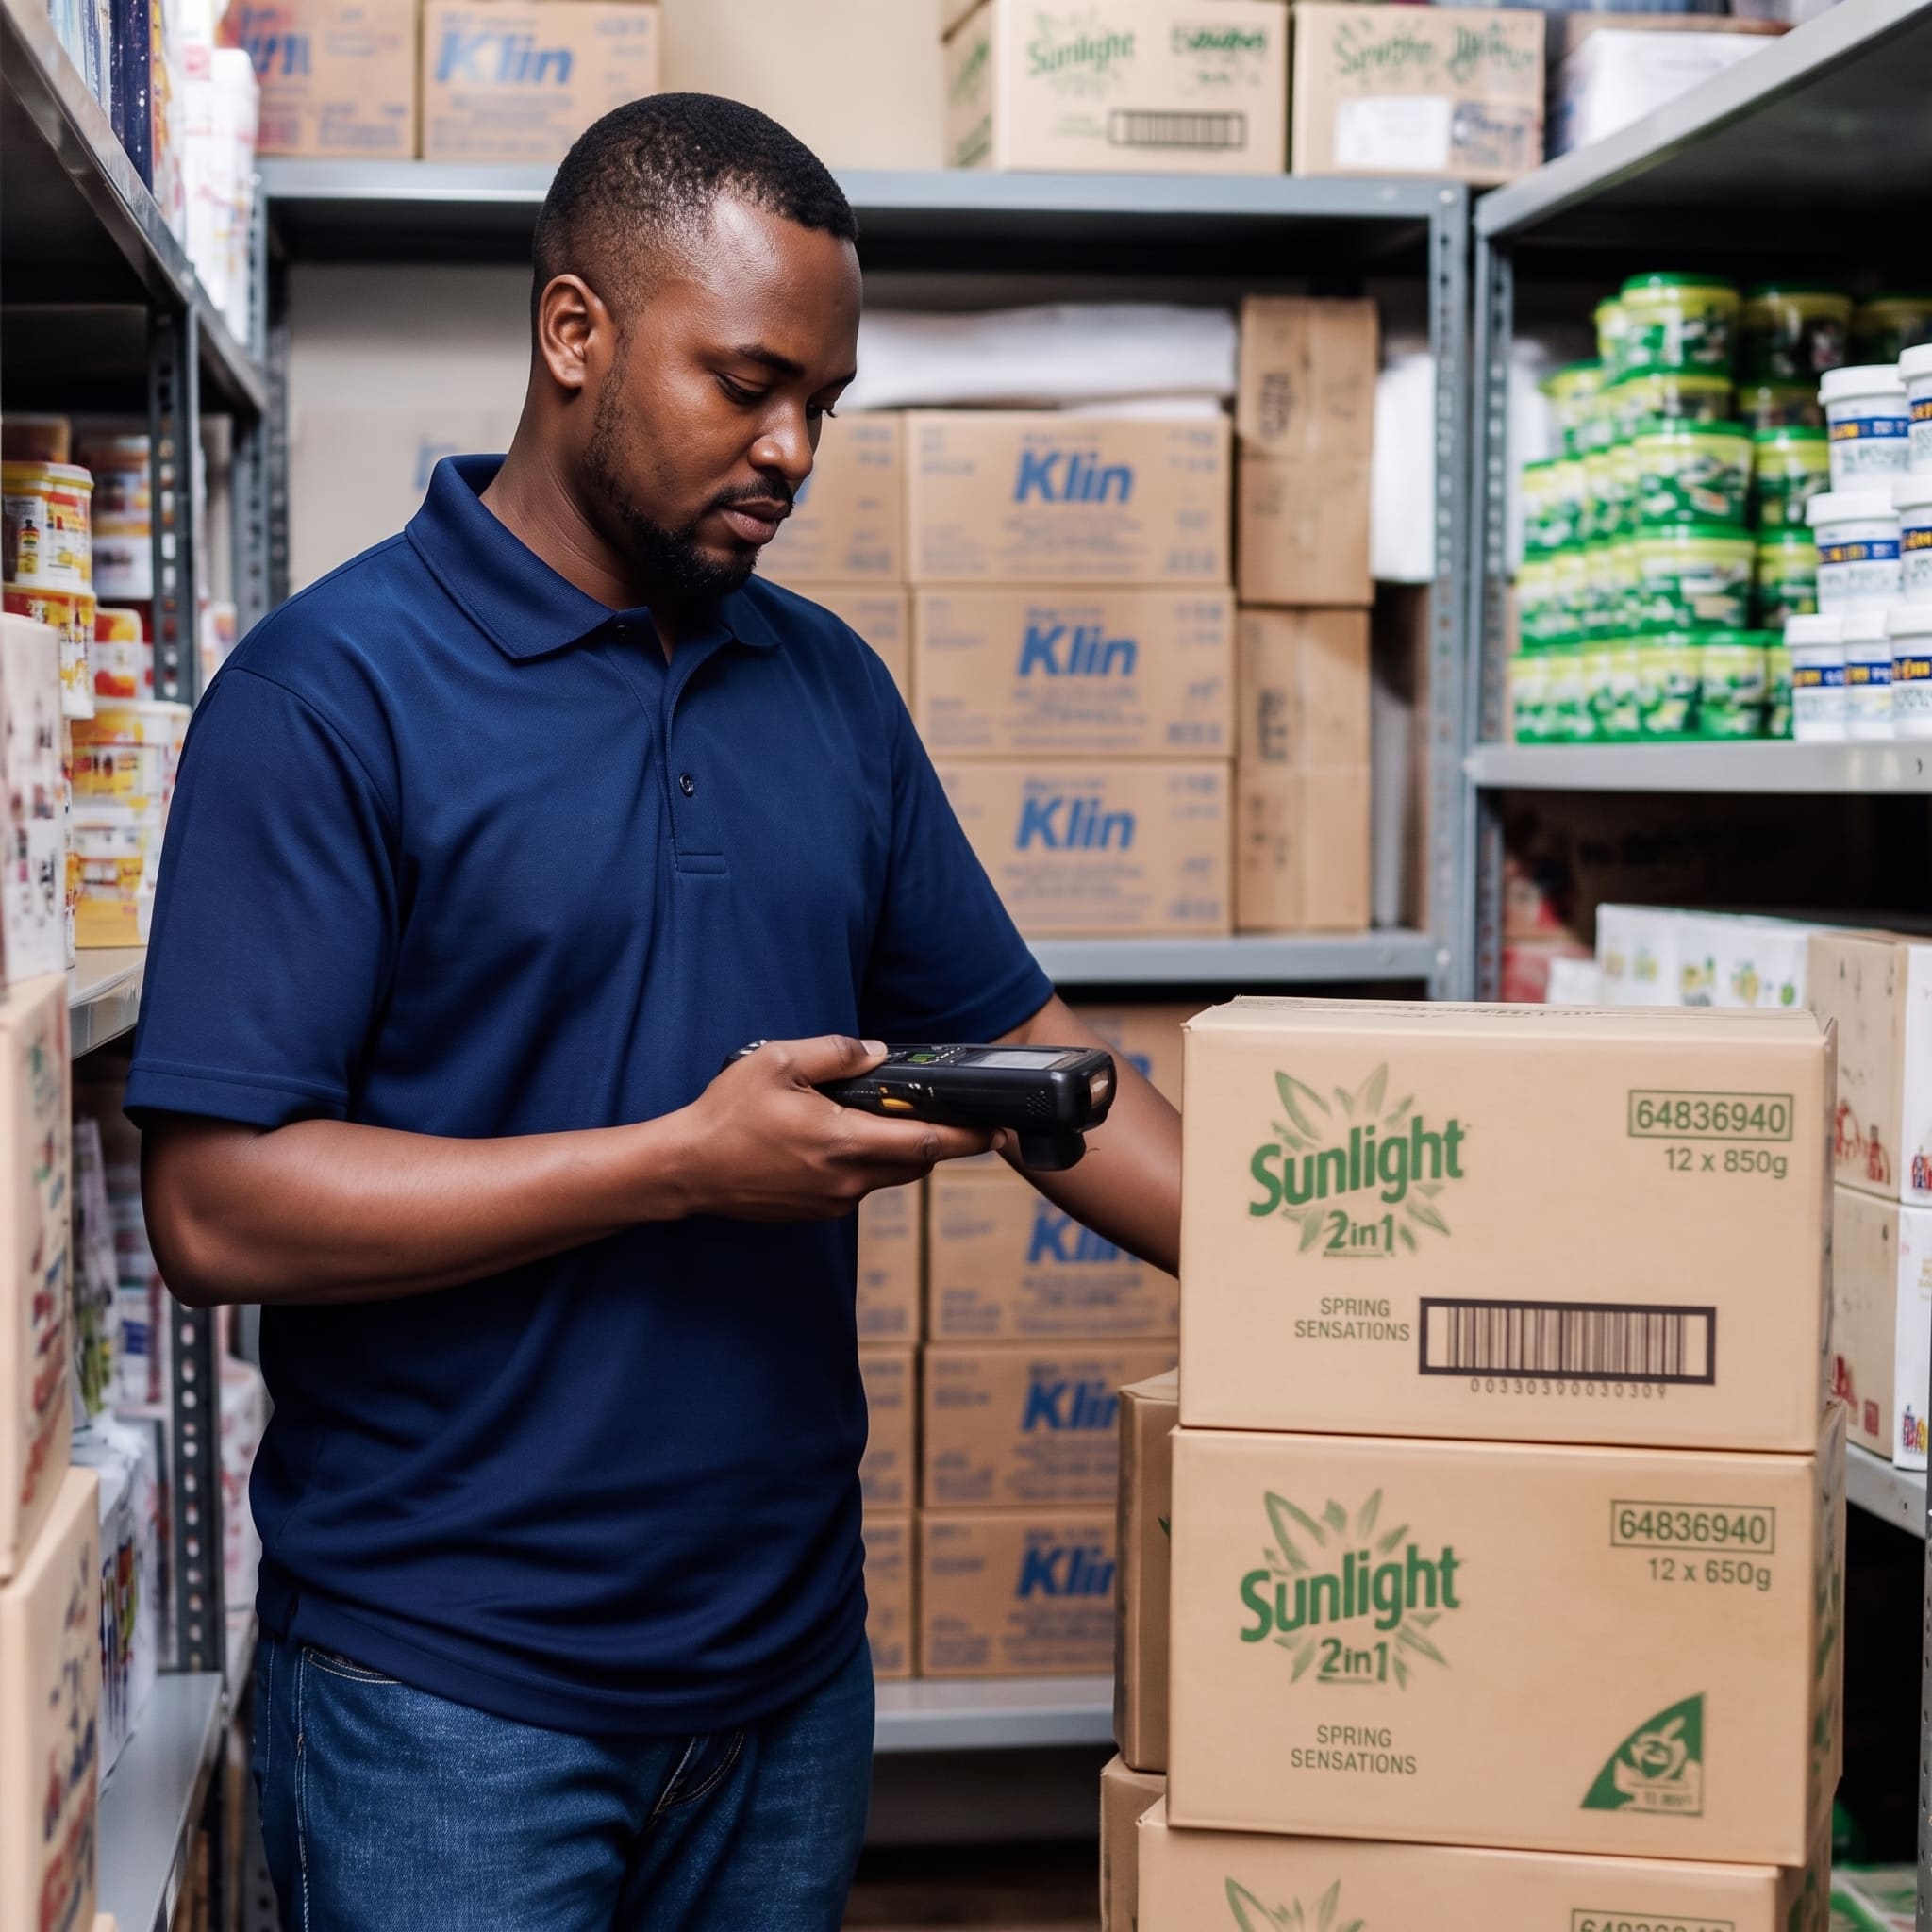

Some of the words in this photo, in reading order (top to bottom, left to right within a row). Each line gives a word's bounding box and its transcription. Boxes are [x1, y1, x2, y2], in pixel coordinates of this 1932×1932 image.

[433, 31, 575, 86] Klin
[1013, 450, 1134, 504] Klin
[1017, 624, 1138, 677] Klin
[1015, 796, 1137, 850] Klin
[1636, 1099, 1787, 1134] 64836940
[1248, 1114, 1465, 1218] Sunlight
[1665, 1146, 1693, 1172] 12
[1701, 1153, 1716, 1173] x
[1723, 1148, 1788, 1180] 850g
[1320, 1297, 1391, 1319] SPRING
[1294, 1320, 1411, 1342] SENSATIONS
[1619, 1509, 1767, 1544] 64836940
[1648, 1557, 1676, 1582] 12
[1683, 1564, 1697, 1582] x
[1705, 1559, 1772, 1592] 650g
[1239, 1543, 1461, 1643] Sunlight
[1316, 1725, 1392, 1748] SPRING
[1291, 1748, 1417, 1774] SENSATIONS
